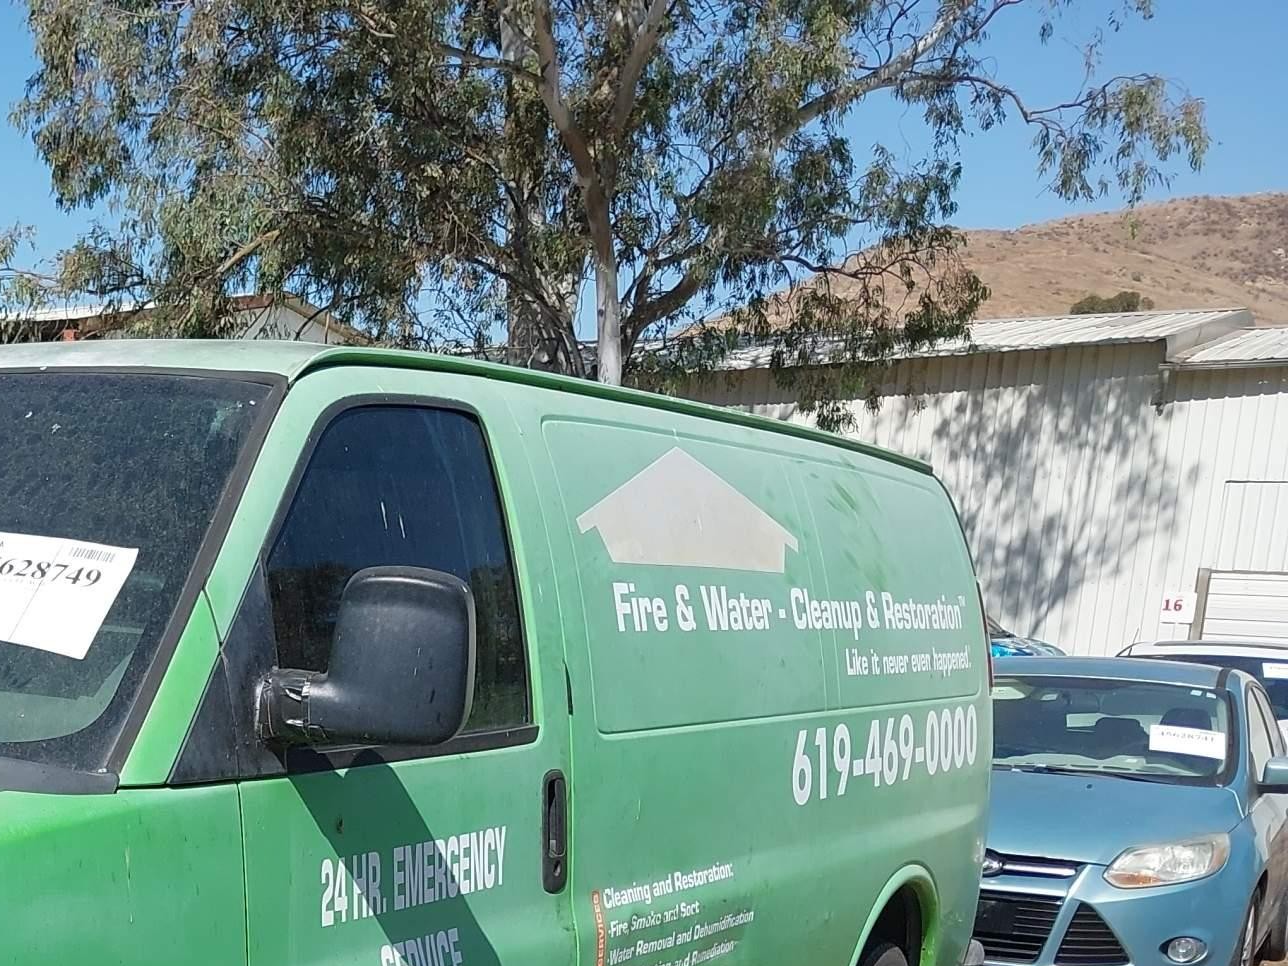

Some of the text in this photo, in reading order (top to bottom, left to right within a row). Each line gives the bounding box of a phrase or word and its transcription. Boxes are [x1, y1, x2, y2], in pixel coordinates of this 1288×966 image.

[612, 582, 668, 631] Fire
[675, 585, 696, 631] &
[700, 585, 772, 631] Water
[790, 588, 861, 640] Cleanup
[865, 590, 880, 629] &
[1162, 599, 1183, 611] 16
[846, 648, 869, 675] Like
[871, 649, 880, 675] it
[883, 654, 908, 673] never
[912, 652, 931, 672] even
[792, 704, 978, 806] 619-469-0000
[321, 826, 507, 927] 24 HR. EMERGENCY
[603, 861, 733, 908] Cleaning and Restoration:
[609, 909, 754, 966] Water Removal and Dehumidification
[631, 911, 661, 931] Smoke
[663, 903, 679, 923] and
